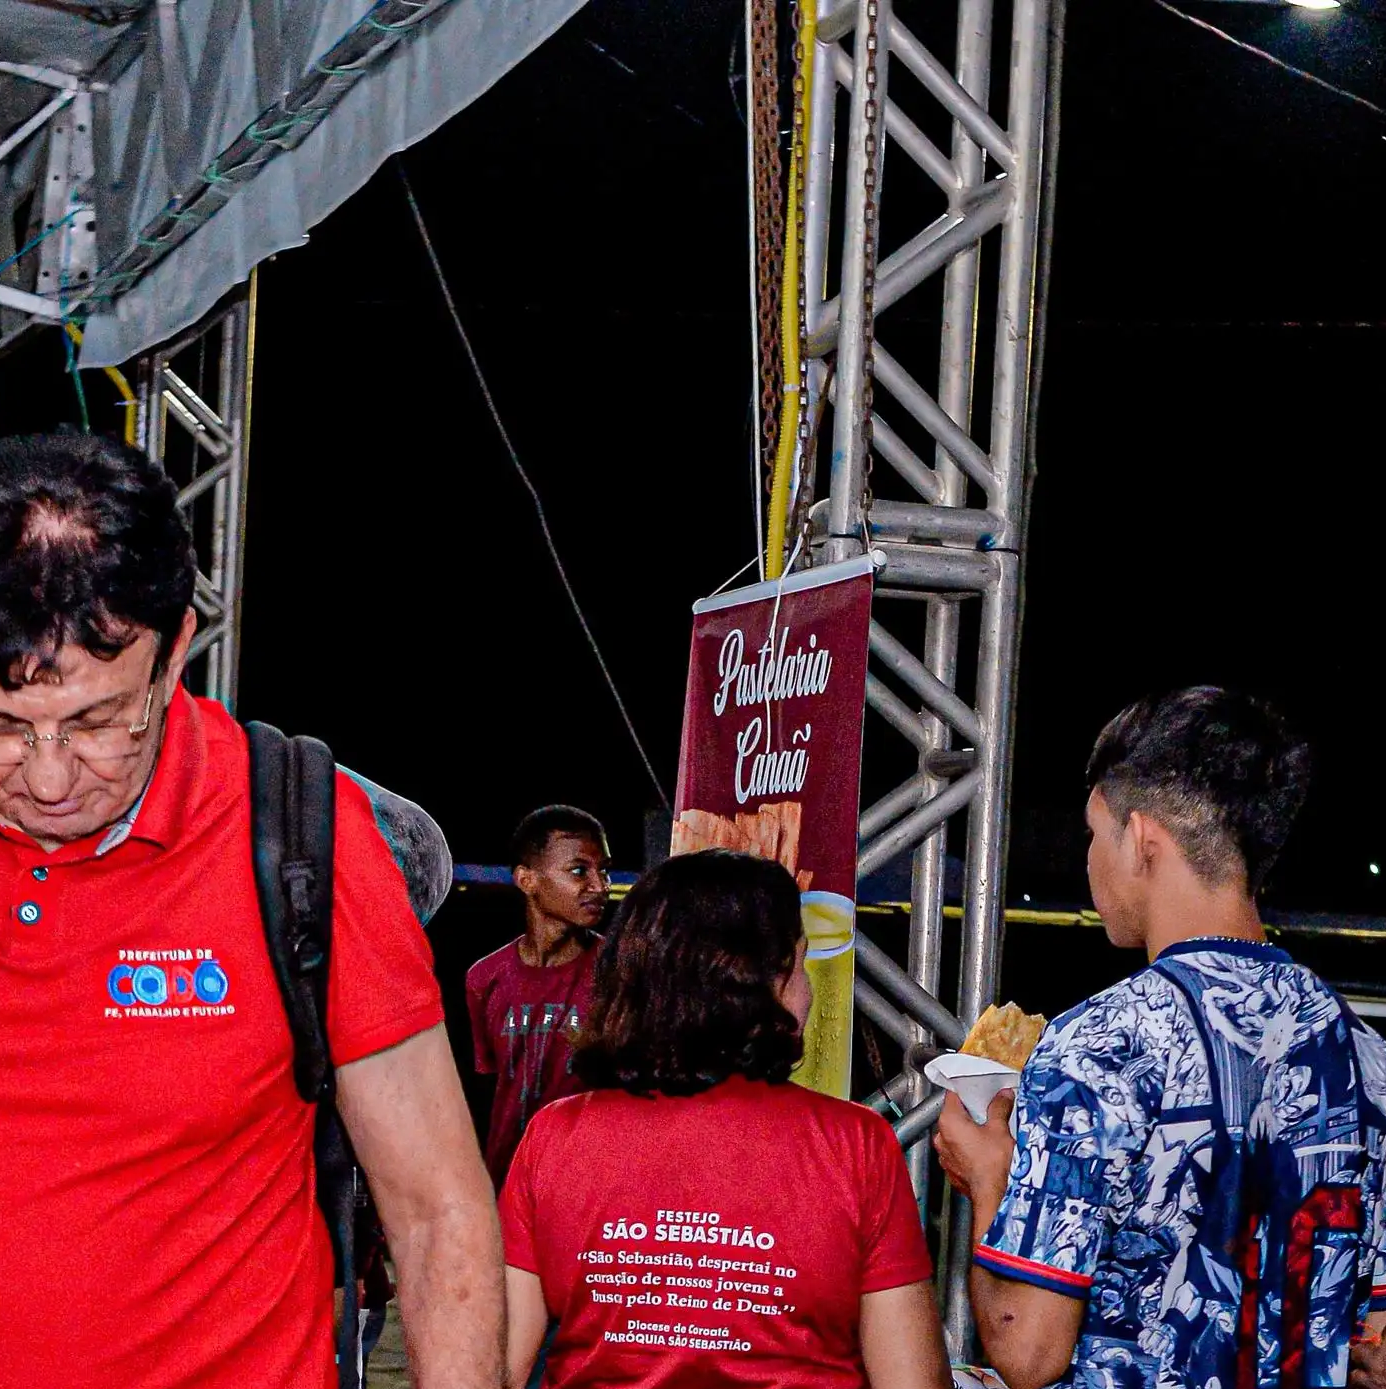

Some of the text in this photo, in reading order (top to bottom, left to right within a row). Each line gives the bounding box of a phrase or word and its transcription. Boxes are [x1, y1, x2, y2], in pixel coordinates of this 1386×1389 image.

[713, 626, 833, 717] Pastelaria
[734, 716, 811, 804] Canaã
[118, 948, 213, 962] PREFEITURA DE
[124, 1007, 181, 1018] TRABALHO
[182, 1007, 190, 1017] E
[191, 1005, 236, 1017] FUTURO
[657, 1209, 720, 1225] FESTEJO
[602, 1218, 775, 1251] SÃO SEBASTIÃO
[617, 1250, 694, 1270] Sebastião,
[697, 1255, 771, 1275] despertai
[774, 1267, 797, 1279] no
[641, 1273, 662, 1286] de
[665, 1276, 713, 1290] nossos
[714, 1277, 769, 1295] jovens
[773, 1287, 784, 1297] a
[626, 1293, 662, 1308] pelo
[666, 1293, 708, 1309] Reino
[712, 1298, 732, 1312] de
[627, 1319, 731, 1338] Diocese de Coroatá
[604, 1331, 752, 1352] PARÓQUIA SÃO SEBASTIÃO
